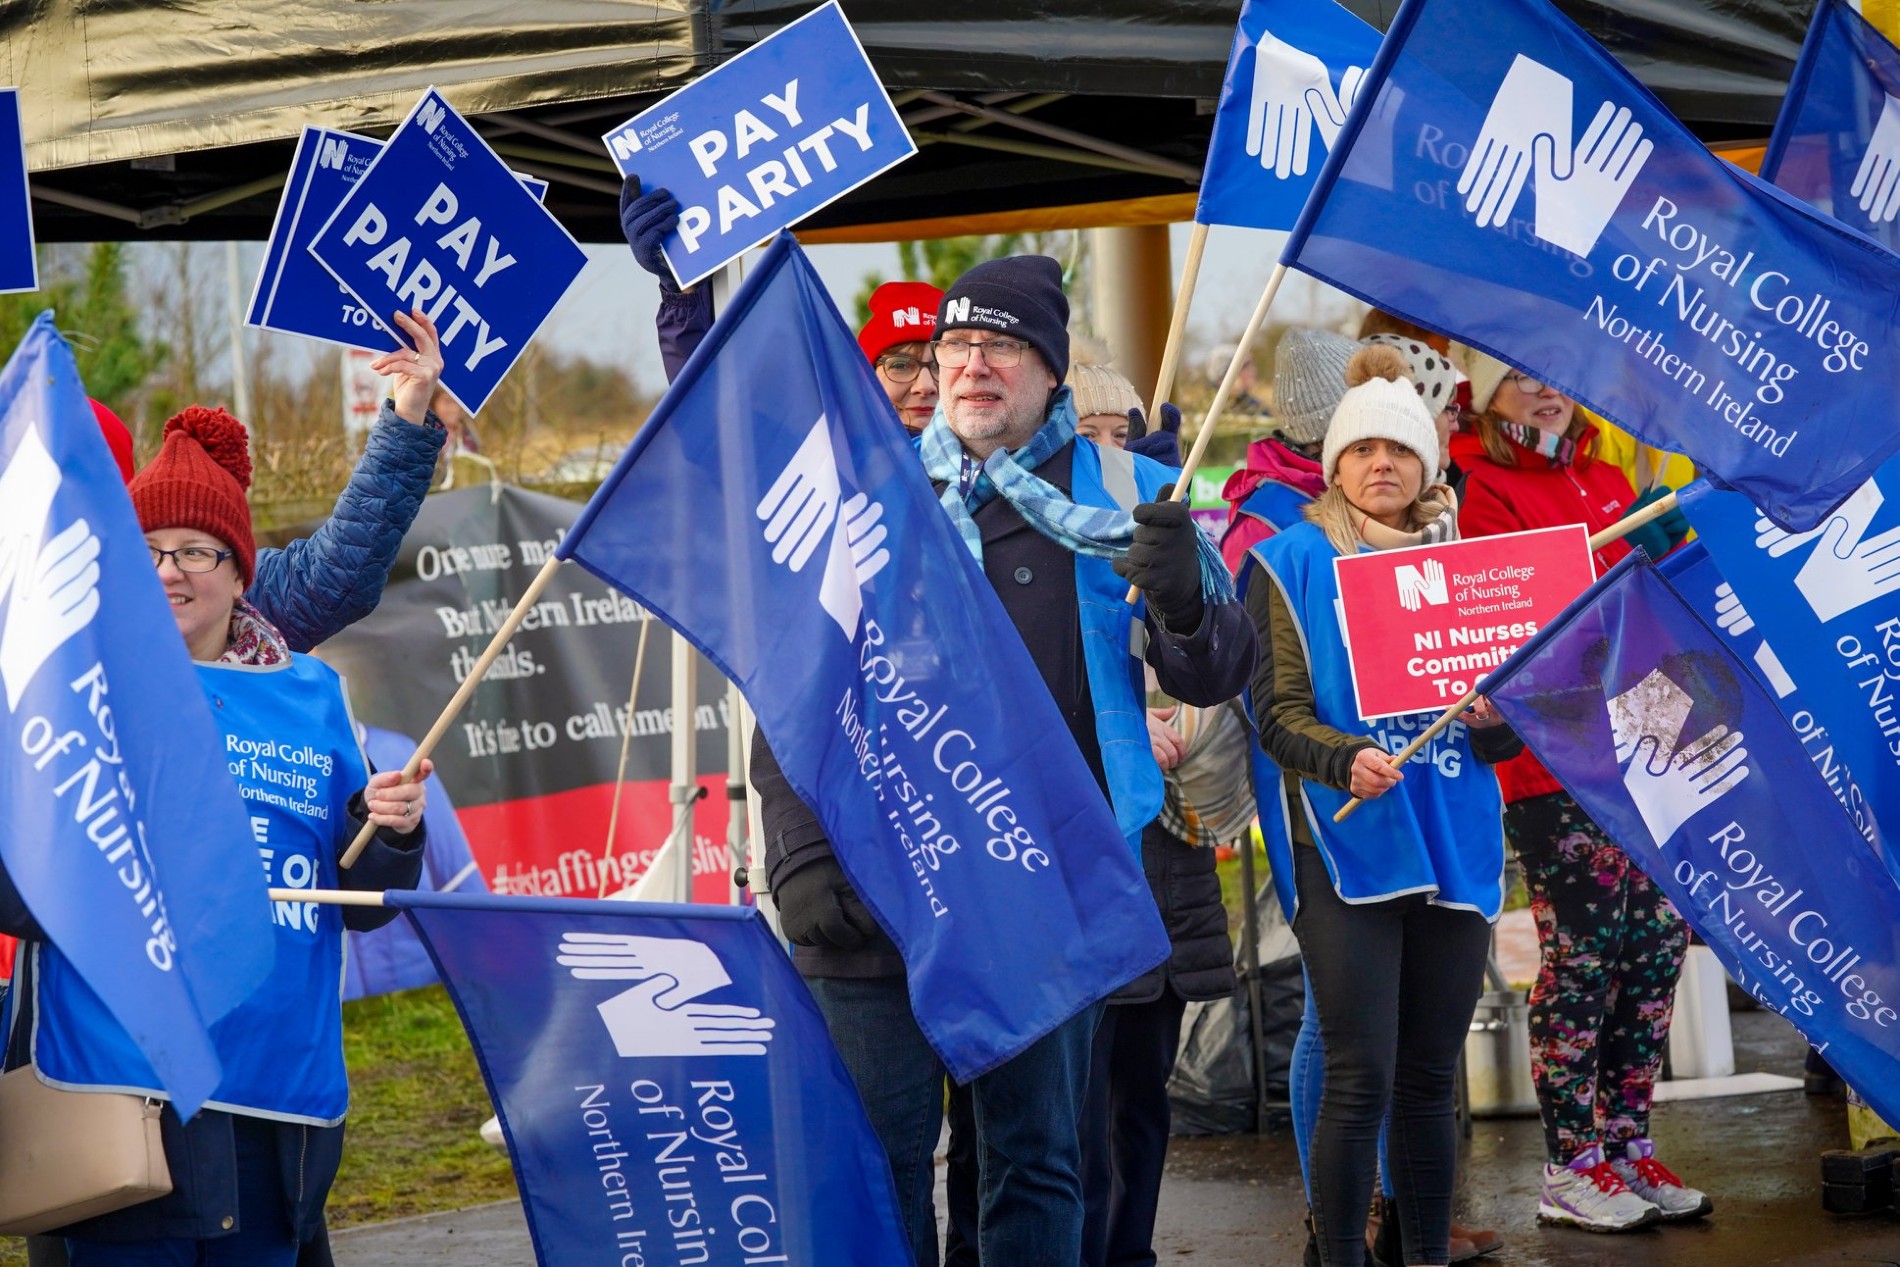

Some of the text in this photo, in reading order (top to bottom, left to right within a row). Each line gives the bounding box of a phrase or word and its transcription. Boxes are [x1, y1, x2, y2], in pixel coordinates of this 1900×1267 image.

[432, 134, 442, 142] of
[439, 124, 454, 142] Royal
[640, 111, 680, 138] Royal College
[643, 124, 676, 146] of Nursing
[688, 78, 803, 179] PAY
[676, 102, 874, 254] PARITY
[414, 182, 517, 288] PAY
[342, 202, 508, 372] PARITY
[1641, 196, 1869, 373] Royal College
[342, 305, 368, 326] TO
[970, 314, 1007, 329] of Nursing
[973, 306, 993, 318] Royal
[1612, 254, 1799, 404] of Nursing
[1583, 295, 1797, 458] Northern Ireland
[1453, 565, 1535, 588] Royal College
[1455, 584, 1521, 602] of Nursing
[1458, 597, 1533, 617] Northern Ireland
[1413, 620, 1538, 652] NI Nurses
[1836, 635, 1880, 669] of
[1432, 678, 1468, 698] To
[21, 715, 87, 772] of
[521, 719, 557, 750] to
[566, 702, 616, 740] call
[614, 702, 674, 738] time
[860, 619, 1050, 872] Royal College
[1792, 710, 1829, 744] of
[226, 734, 276, 761] Royal
[228, 758, 318, 799] of Nursing
[289, 797, 329, 821] Ireland
[835, 687, 949, 918] Northern Ireland
[53, 758, 177, 972] Nursing
[1674, 860, 1824, 1017] of Nursing
[1708, 820, 1898, 1028] Royal College
[630, 1079, 685, 1121] of
[690, 1080, 768, 1184] Royal
[574, 1084, 635, 1222] Northern
